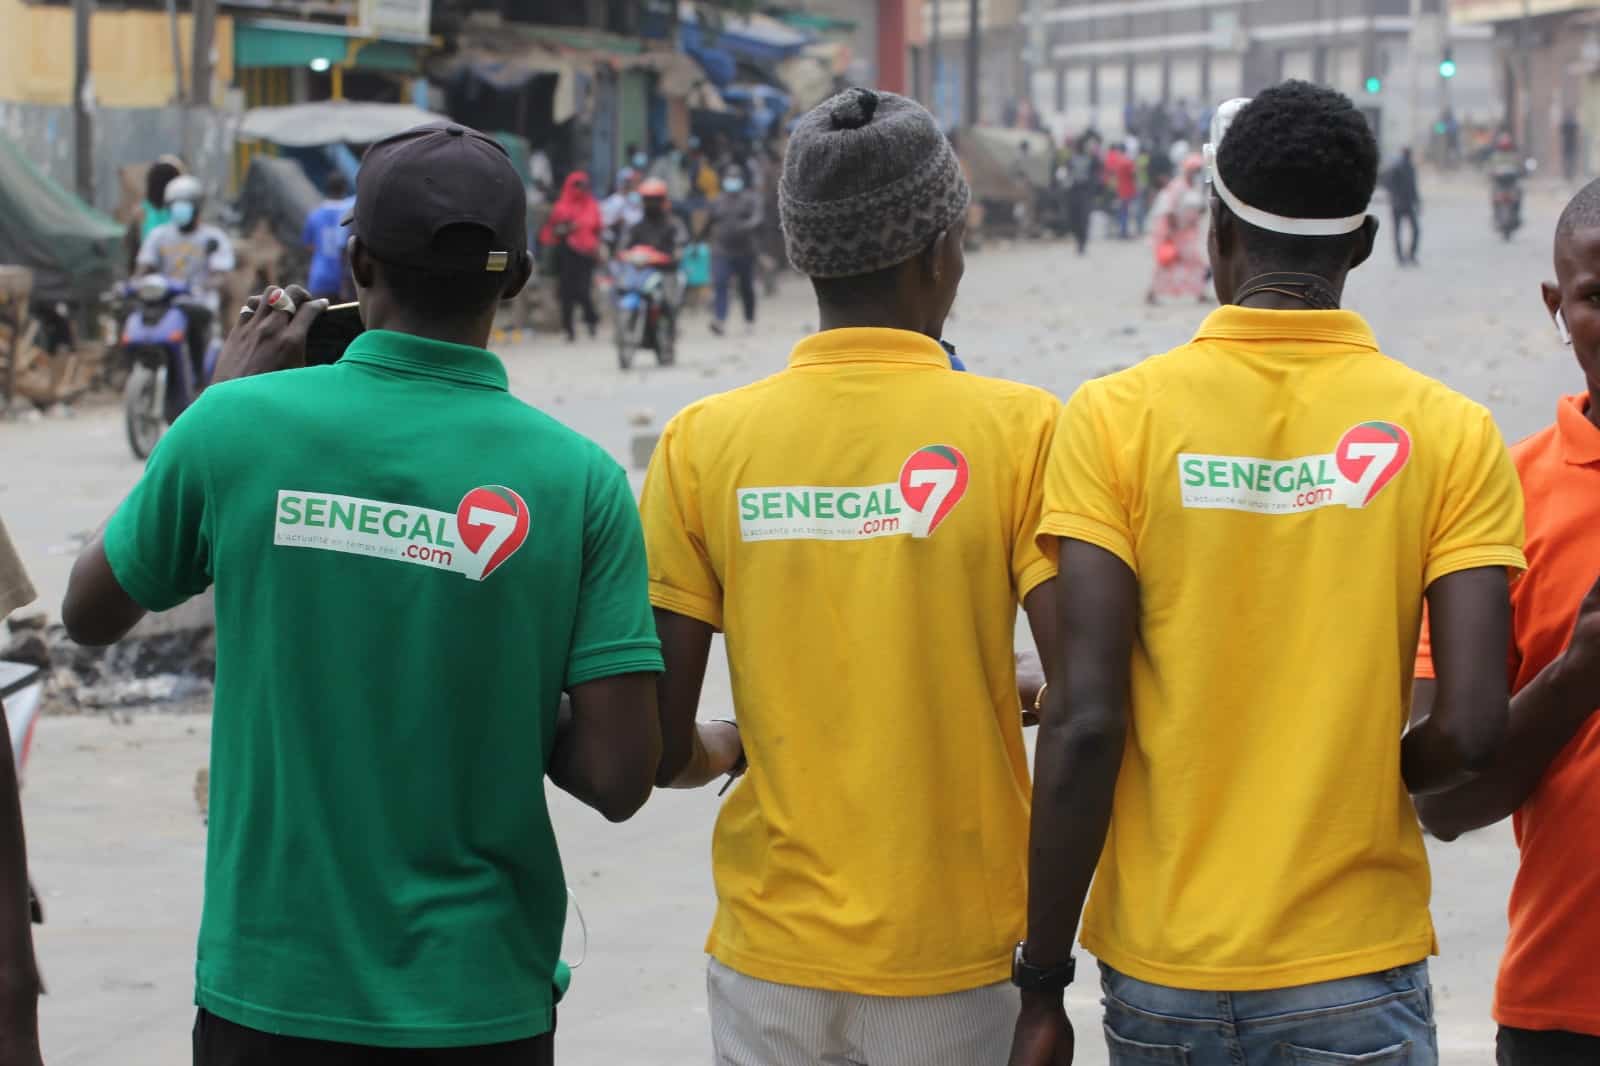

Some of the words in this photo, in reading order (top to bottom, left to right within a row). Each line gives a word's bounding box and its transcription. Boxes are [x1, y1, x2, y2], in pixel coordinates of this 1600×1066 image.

[1183, 459, 1336, 493] SENEGAL
[1346, 442, 1399, 508] 7
[740, 488, 902, 520] SENEGAL
[909, 469, 958, 537] 7
[1292, 487, 1332, 508] .com
[278, 496, 455, 549] SENEGAL
[465, 506, 518, 580] 7
[858, 517, 900, 536] .com
[401, 544, 453, 565] .com
